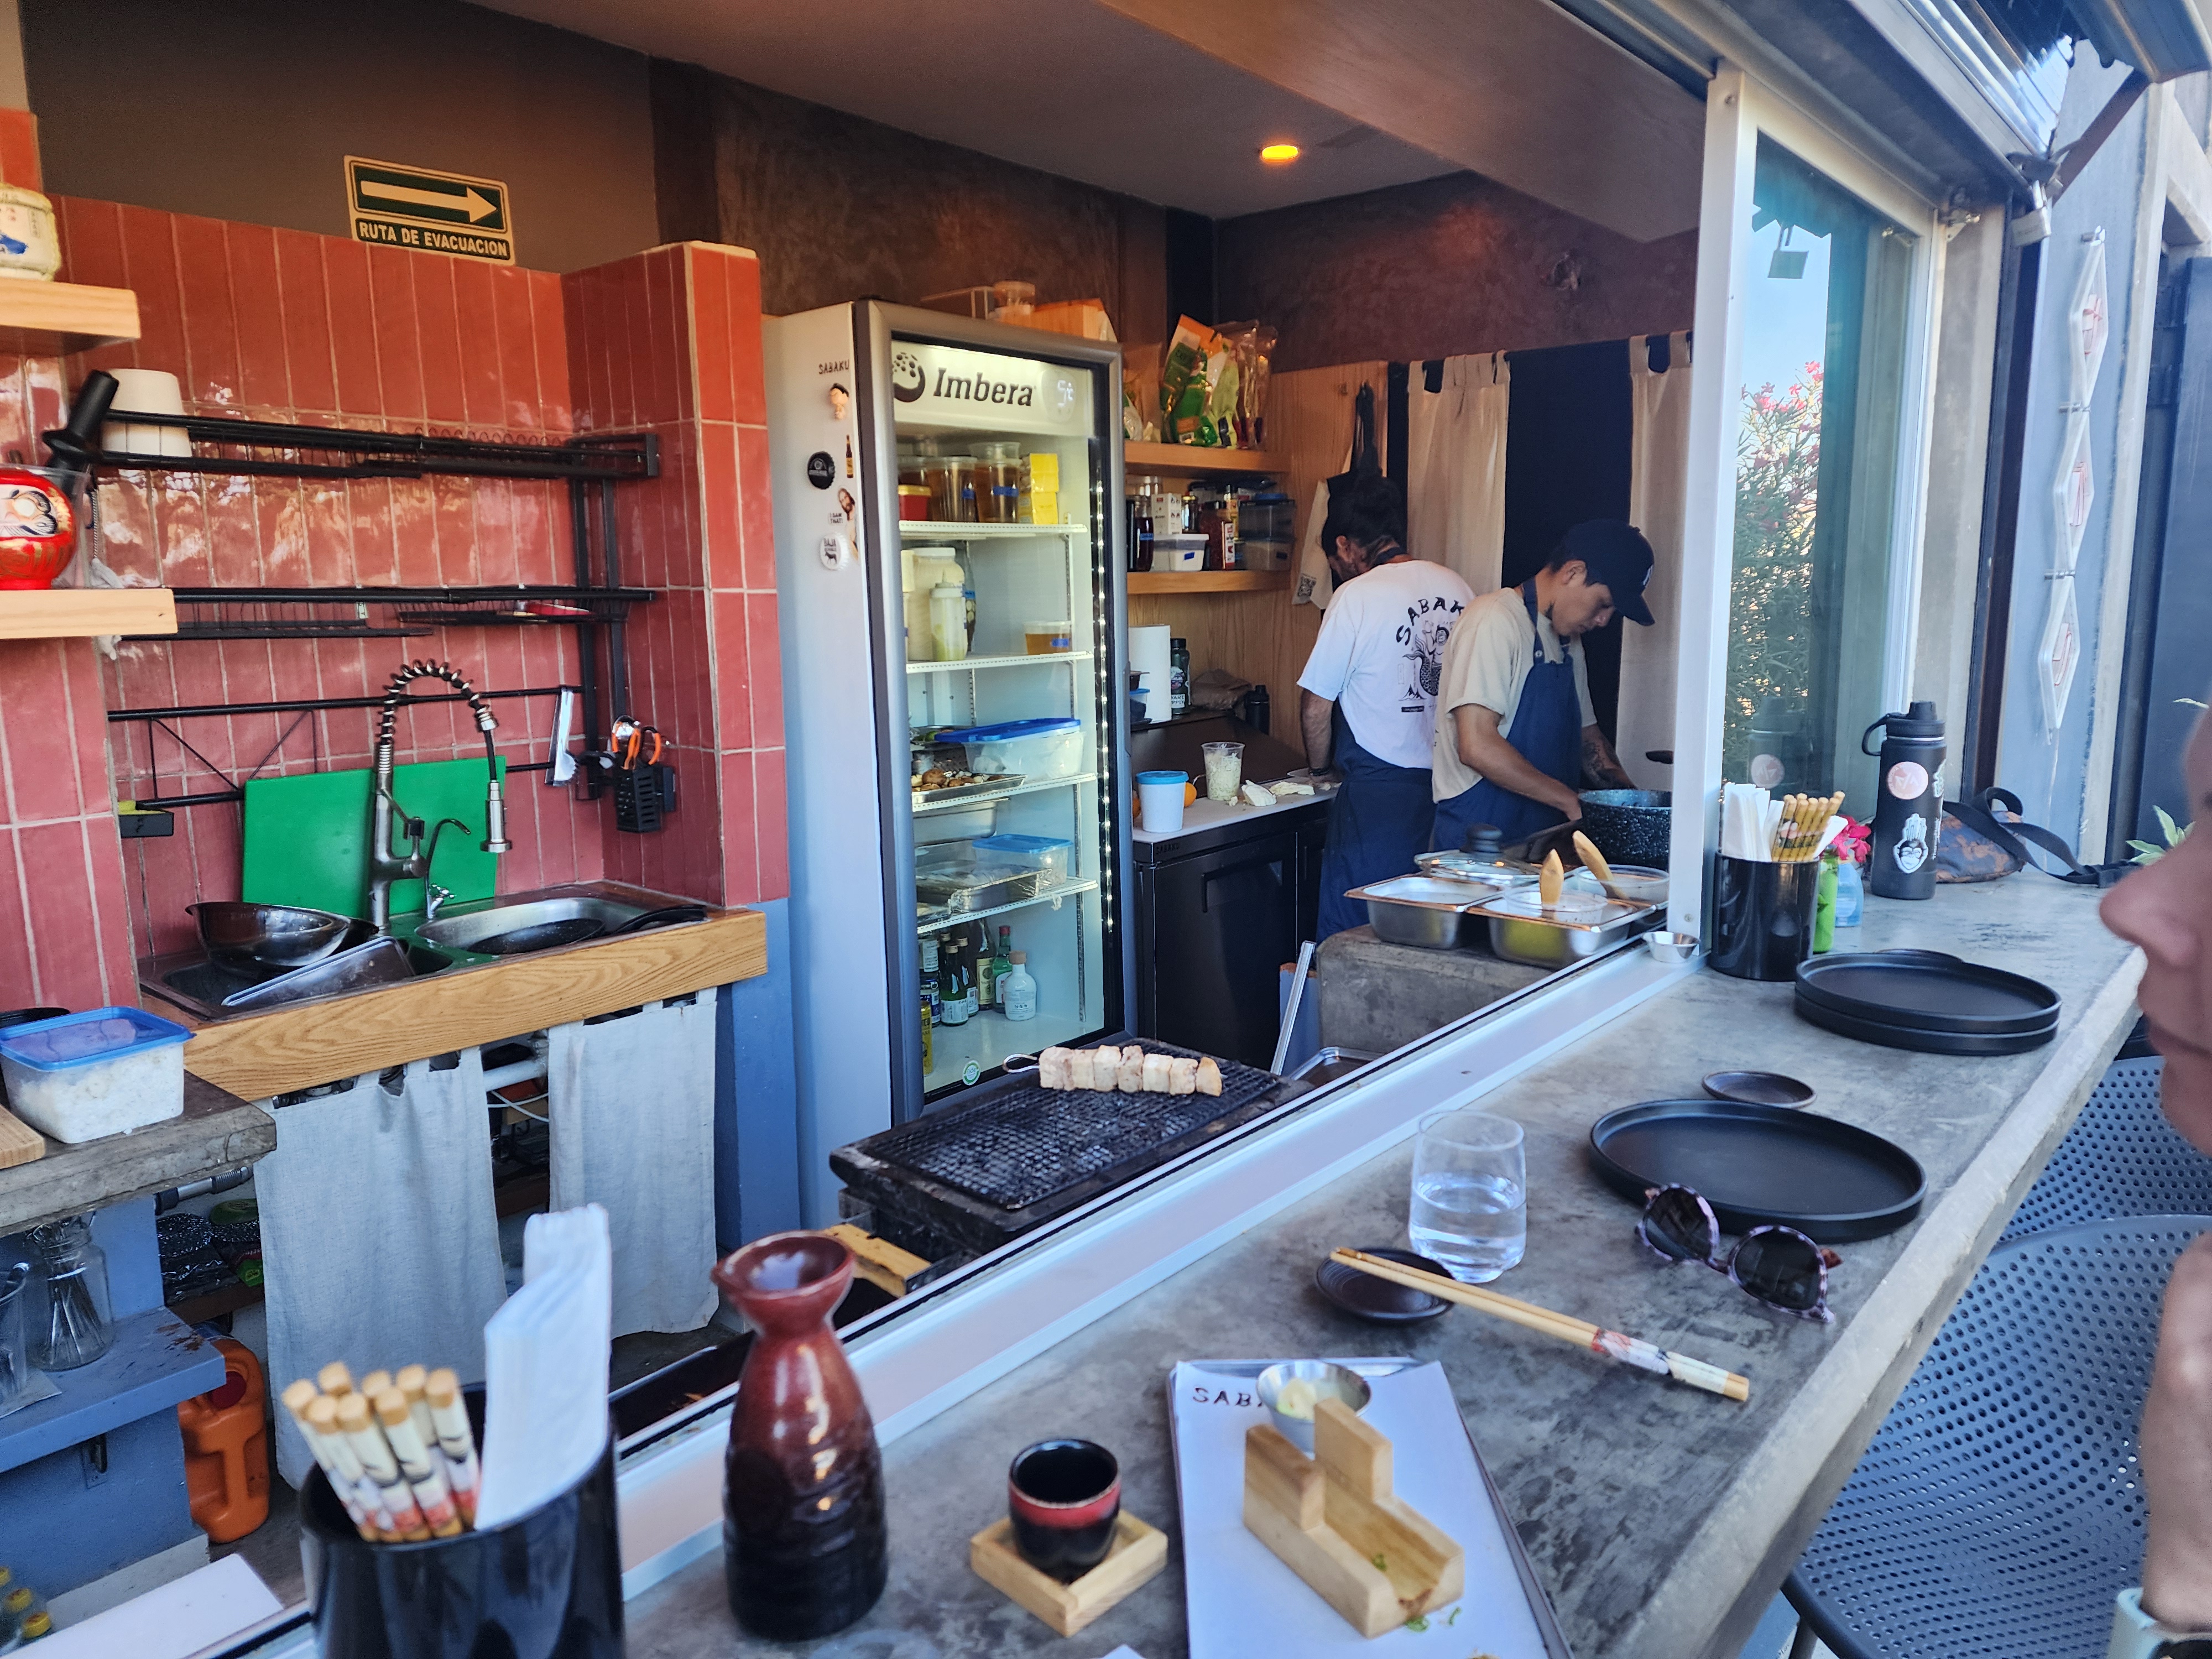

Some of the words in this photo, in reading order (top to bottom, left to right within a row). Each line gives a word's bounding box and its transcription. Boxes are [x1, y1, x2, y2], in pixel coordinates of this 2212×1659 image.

[359, 222, 397, 241] RUTA
[401, 228, 419, 245] DE
[424, 232, 508, 256] EVACUACION
[818, 359, 850, 374] SABAKU
[933, 367, 1034, 406] Imbera
[1192, 1387, 1263, 1408] SAB
